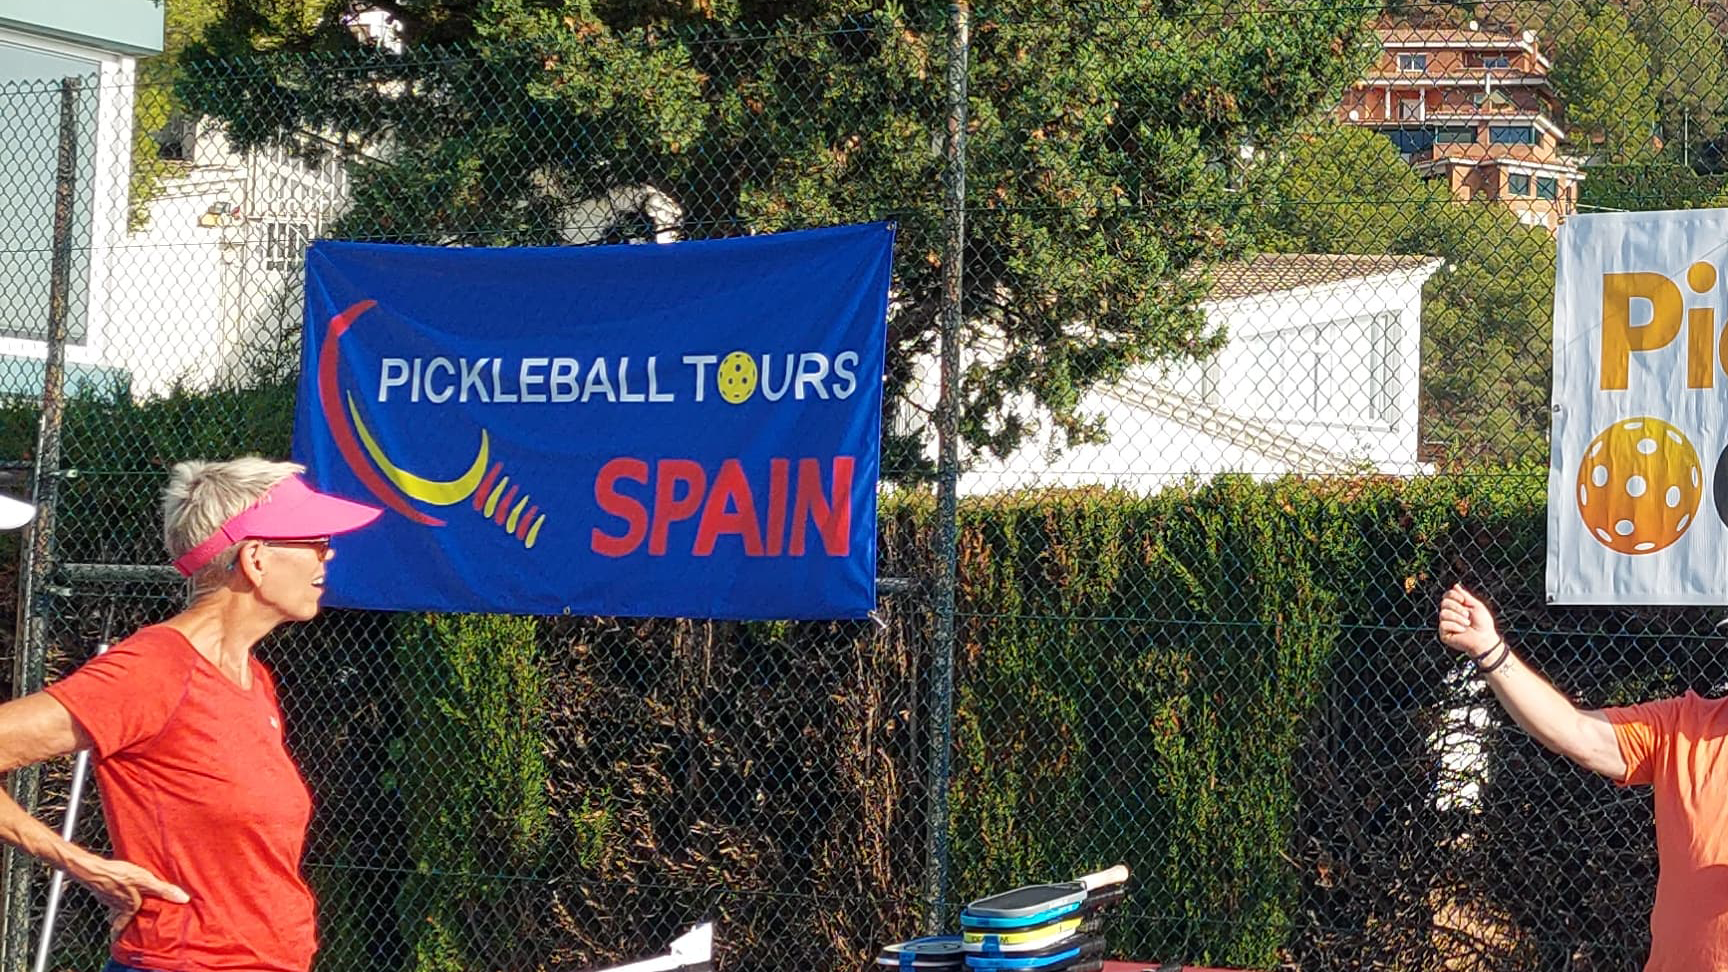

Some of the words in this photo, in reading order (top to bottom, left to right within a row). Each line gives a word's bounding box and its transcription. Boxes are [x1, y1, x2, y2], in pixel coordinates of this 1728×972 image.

[378, 356, 674, 404] PICKLEBALL
[683, 350, 860, 405] TOURS
[591, 456, 855, 558] SPAIN
